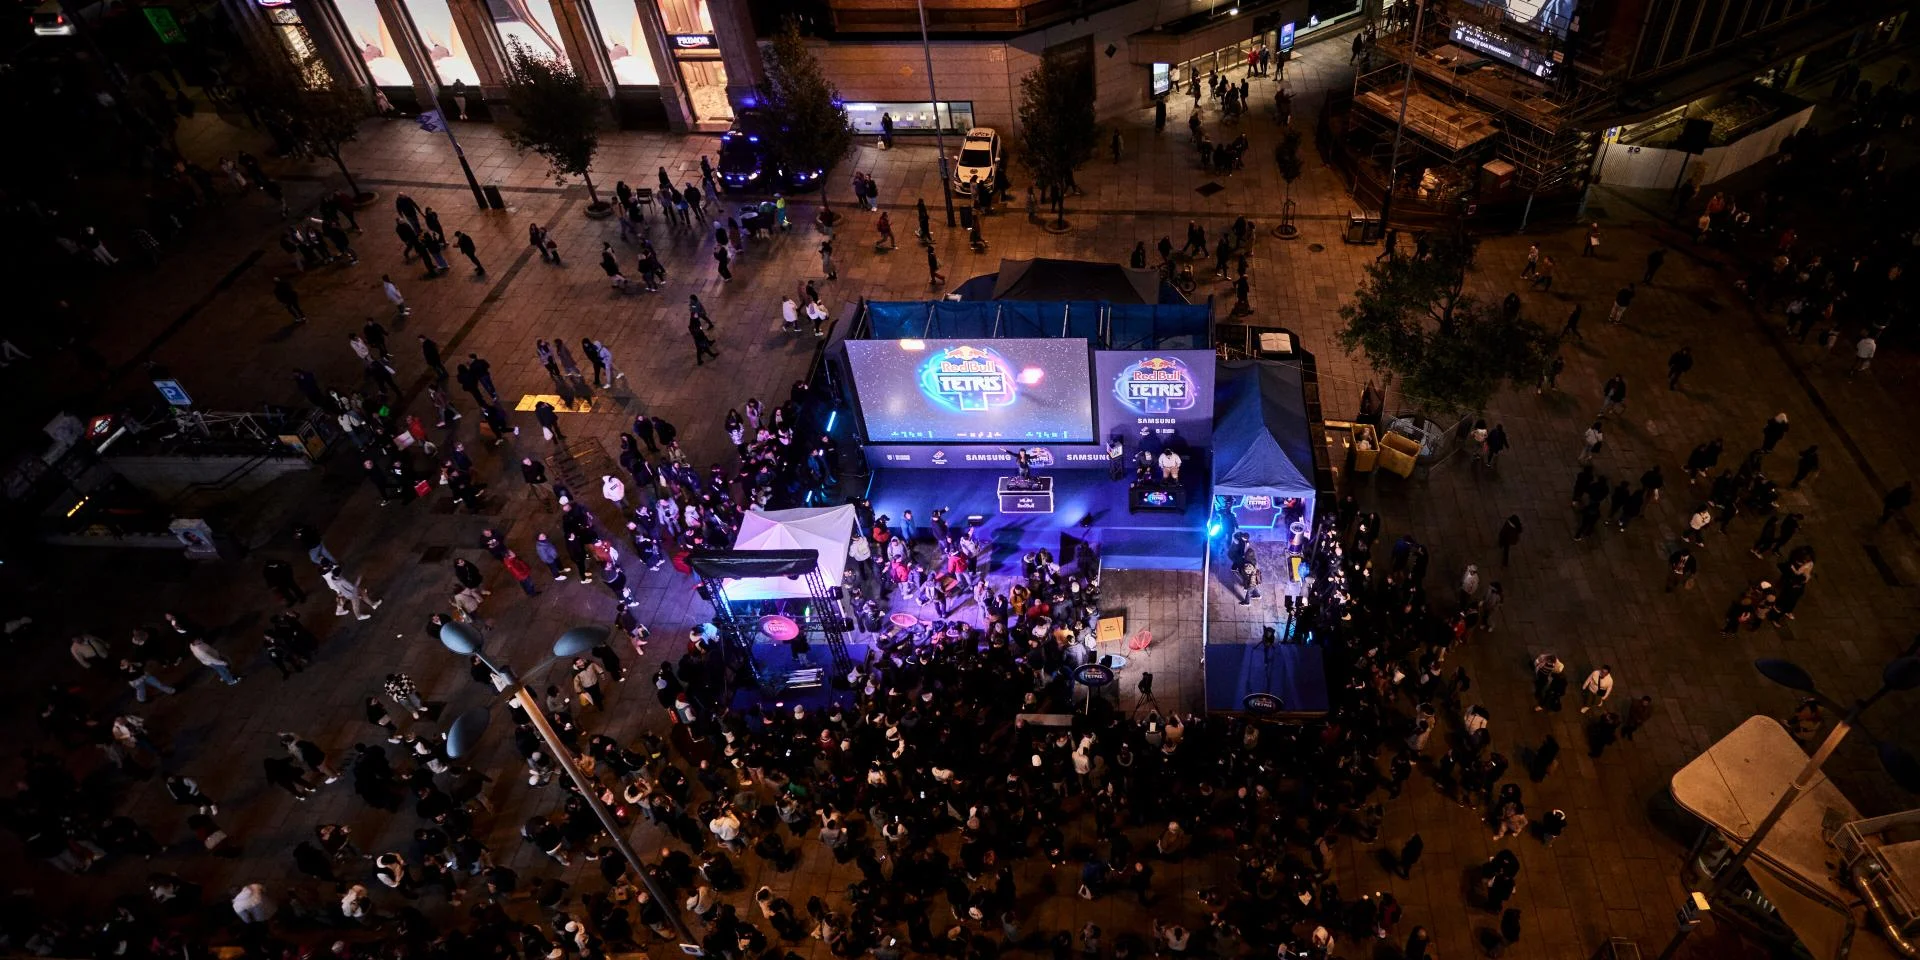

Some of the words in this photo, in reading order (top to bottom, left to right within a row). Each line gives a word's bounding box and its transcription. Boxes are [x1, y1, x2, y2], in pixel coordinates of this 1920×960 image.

[677, 37, 710, 46] PRIMOR
[941, 361, 969, 373] Red
[969, 361, 995, 372] Bull
[1133, 370, 1157, 381] Red
[1157, 371, 1181, 380] Bull
[939, 376, 1001, 391] TETRIS
[1130, 384, 1184, 397] TETRIS
